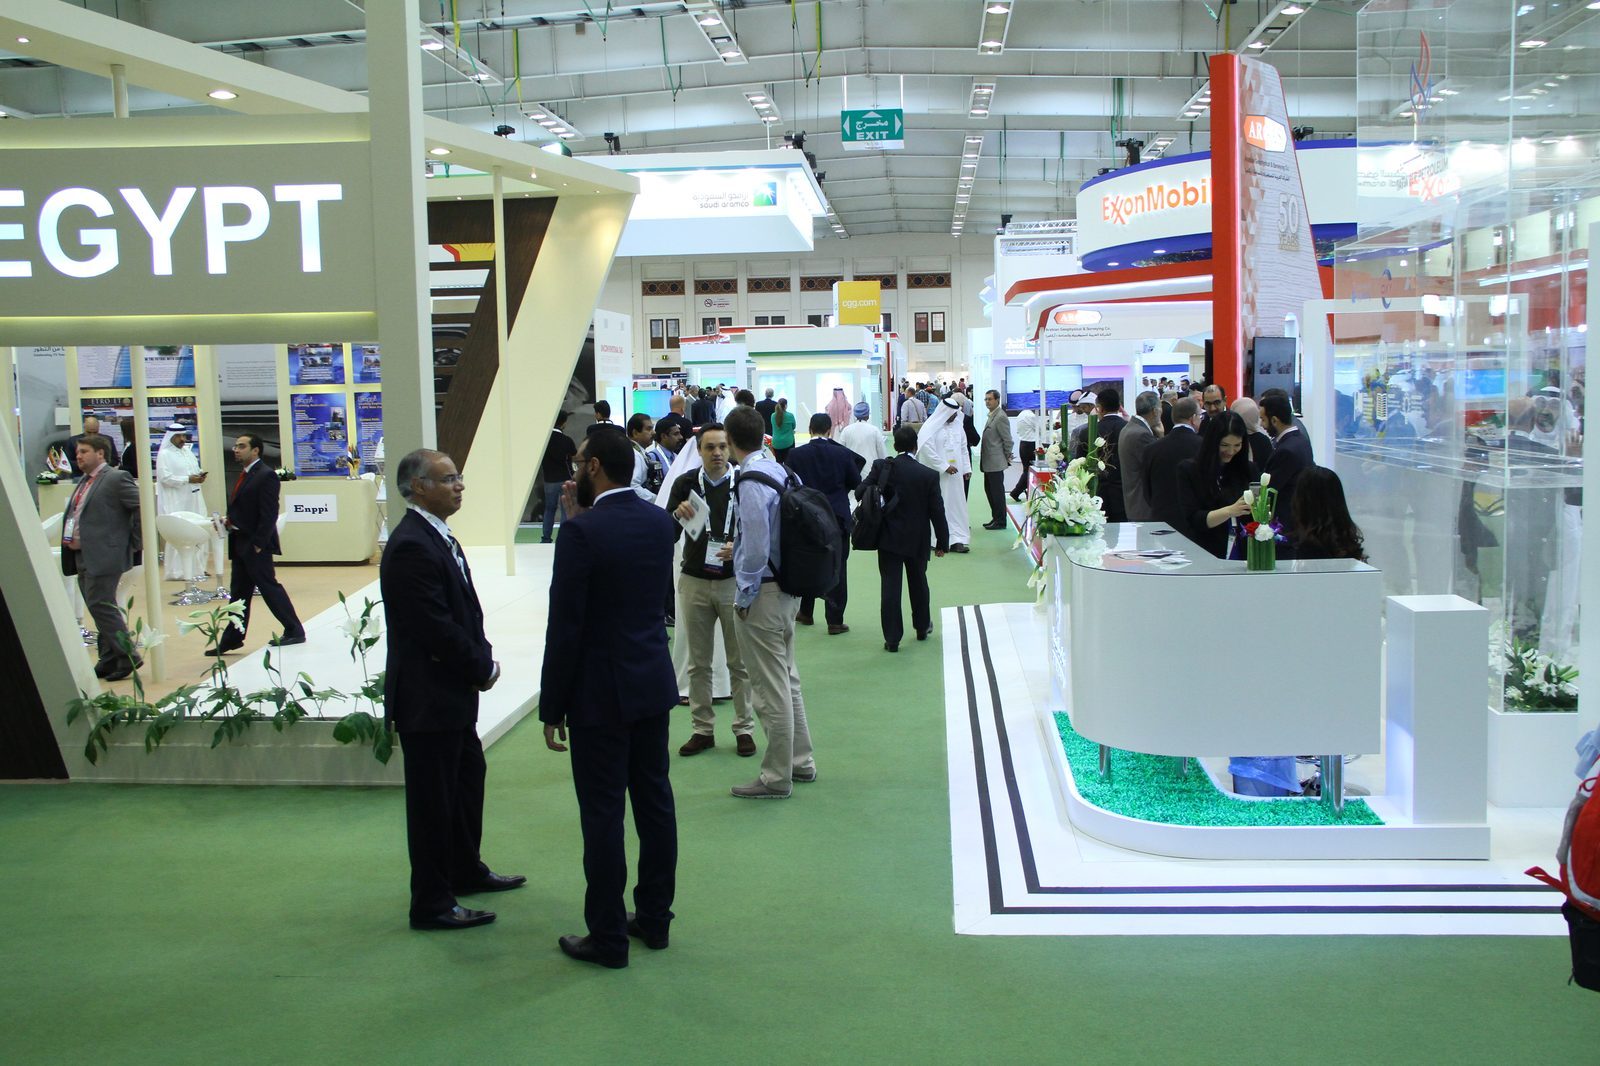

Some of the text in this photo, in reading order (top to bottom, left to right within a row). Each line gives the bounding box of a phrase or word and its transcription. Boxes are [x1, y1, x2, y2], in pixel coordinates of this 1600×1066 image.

[855, 118, 889, 130] مخرج
[855, 131, 889, 140] EXIT
[700, 201, 720, 209] saudi
[1102, 177, 1215, 225] ExxonMobil
[1278, 192, 1299, 234] 50
[842, 299, 878, 309] cgg.com
[294, 503, 329, 515] Enppi
